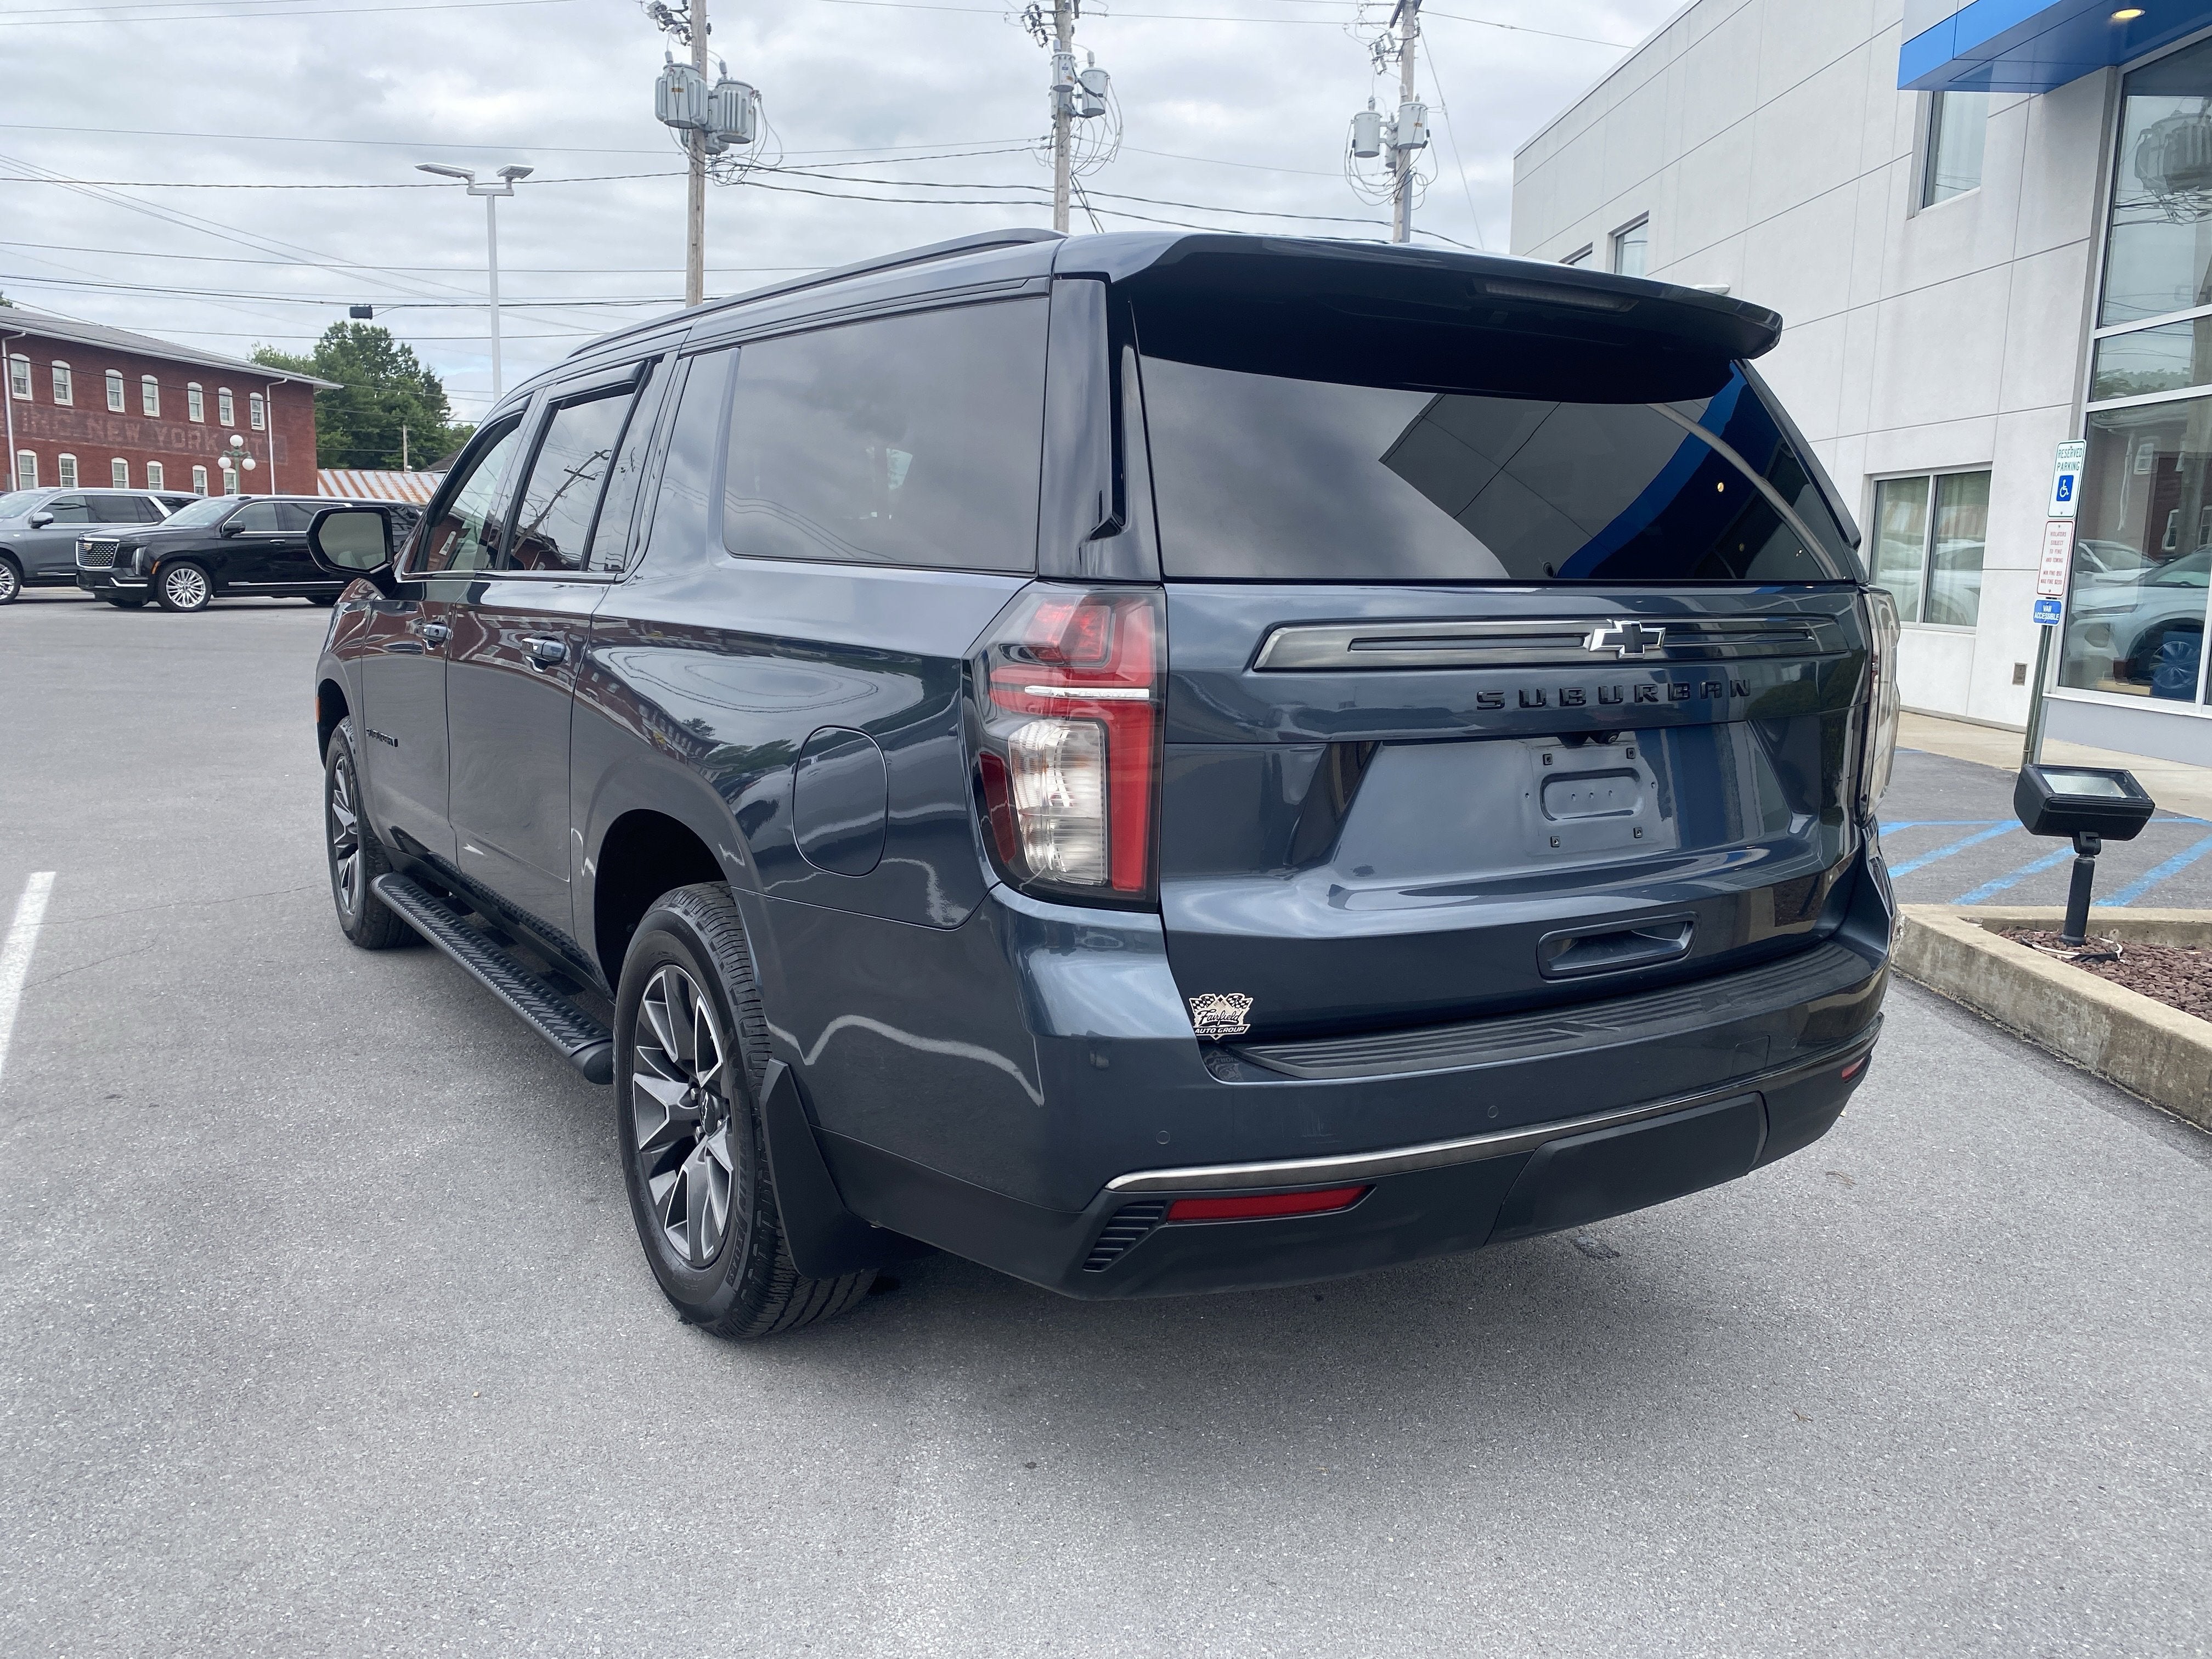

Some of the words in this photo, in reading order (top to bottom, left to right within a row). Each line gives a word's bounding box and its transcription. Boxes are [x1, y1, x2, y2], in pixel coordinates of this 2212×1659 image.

[86, 417, 140, 442] NEW
[155, 427, 218, 452] YORK
[2058, 448, 2083, 458] RESERVED
[2057, 461, 2080, 471] PARKING
[2042, 605, 2052, 613] VAN
[2034, 612, 2060, 621] ACCESSIBLE
[1476, 679, 1751, 710] SUBURBAN
[1197, 1008, 1244, 1026] Fairfield
